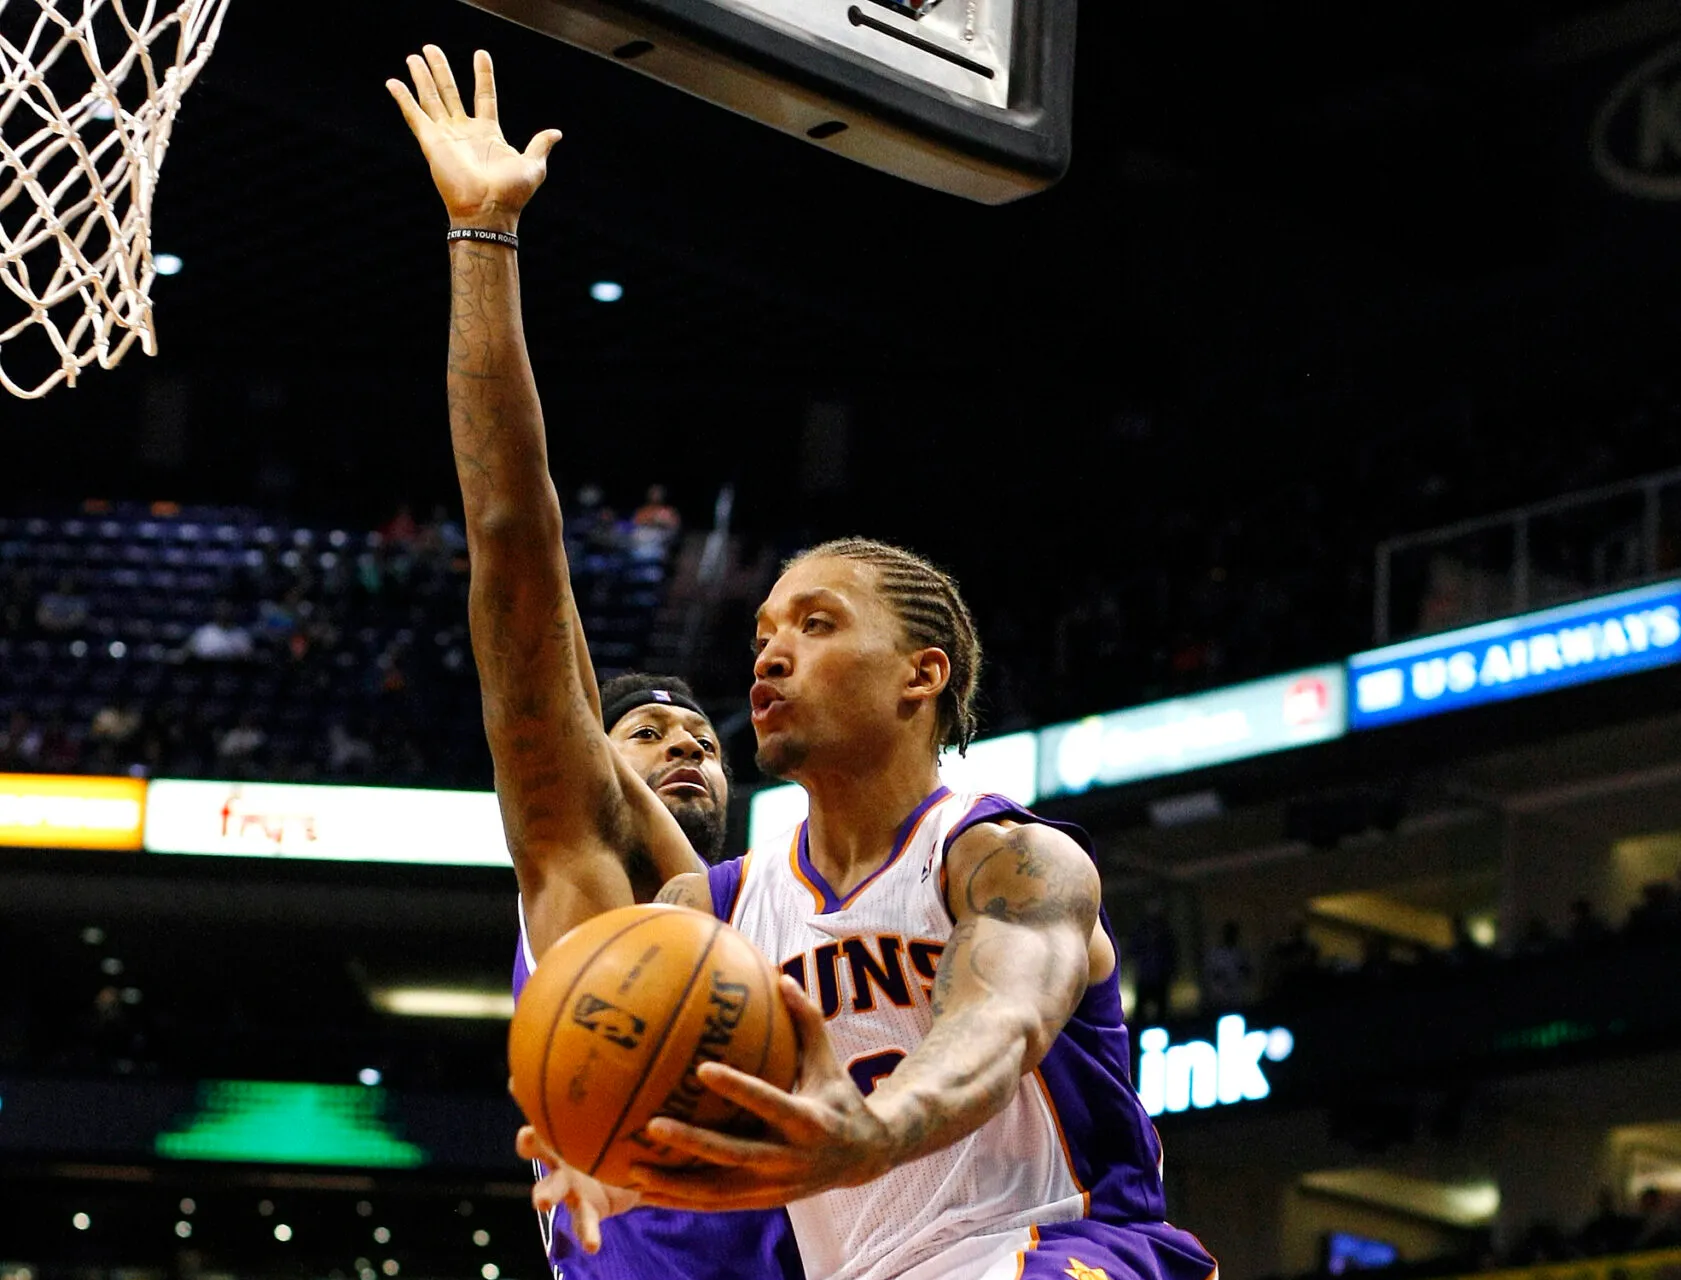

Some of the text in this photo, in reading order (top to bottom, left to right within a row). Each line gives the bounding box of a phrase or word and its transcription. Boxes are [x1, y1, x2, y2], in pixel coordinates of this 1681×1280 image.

[474, 231, 497, 240] YOUR
[1411, 604, 1680, 700] US AIRWAYS
[1138, 1013, 1271, 1117] ink
